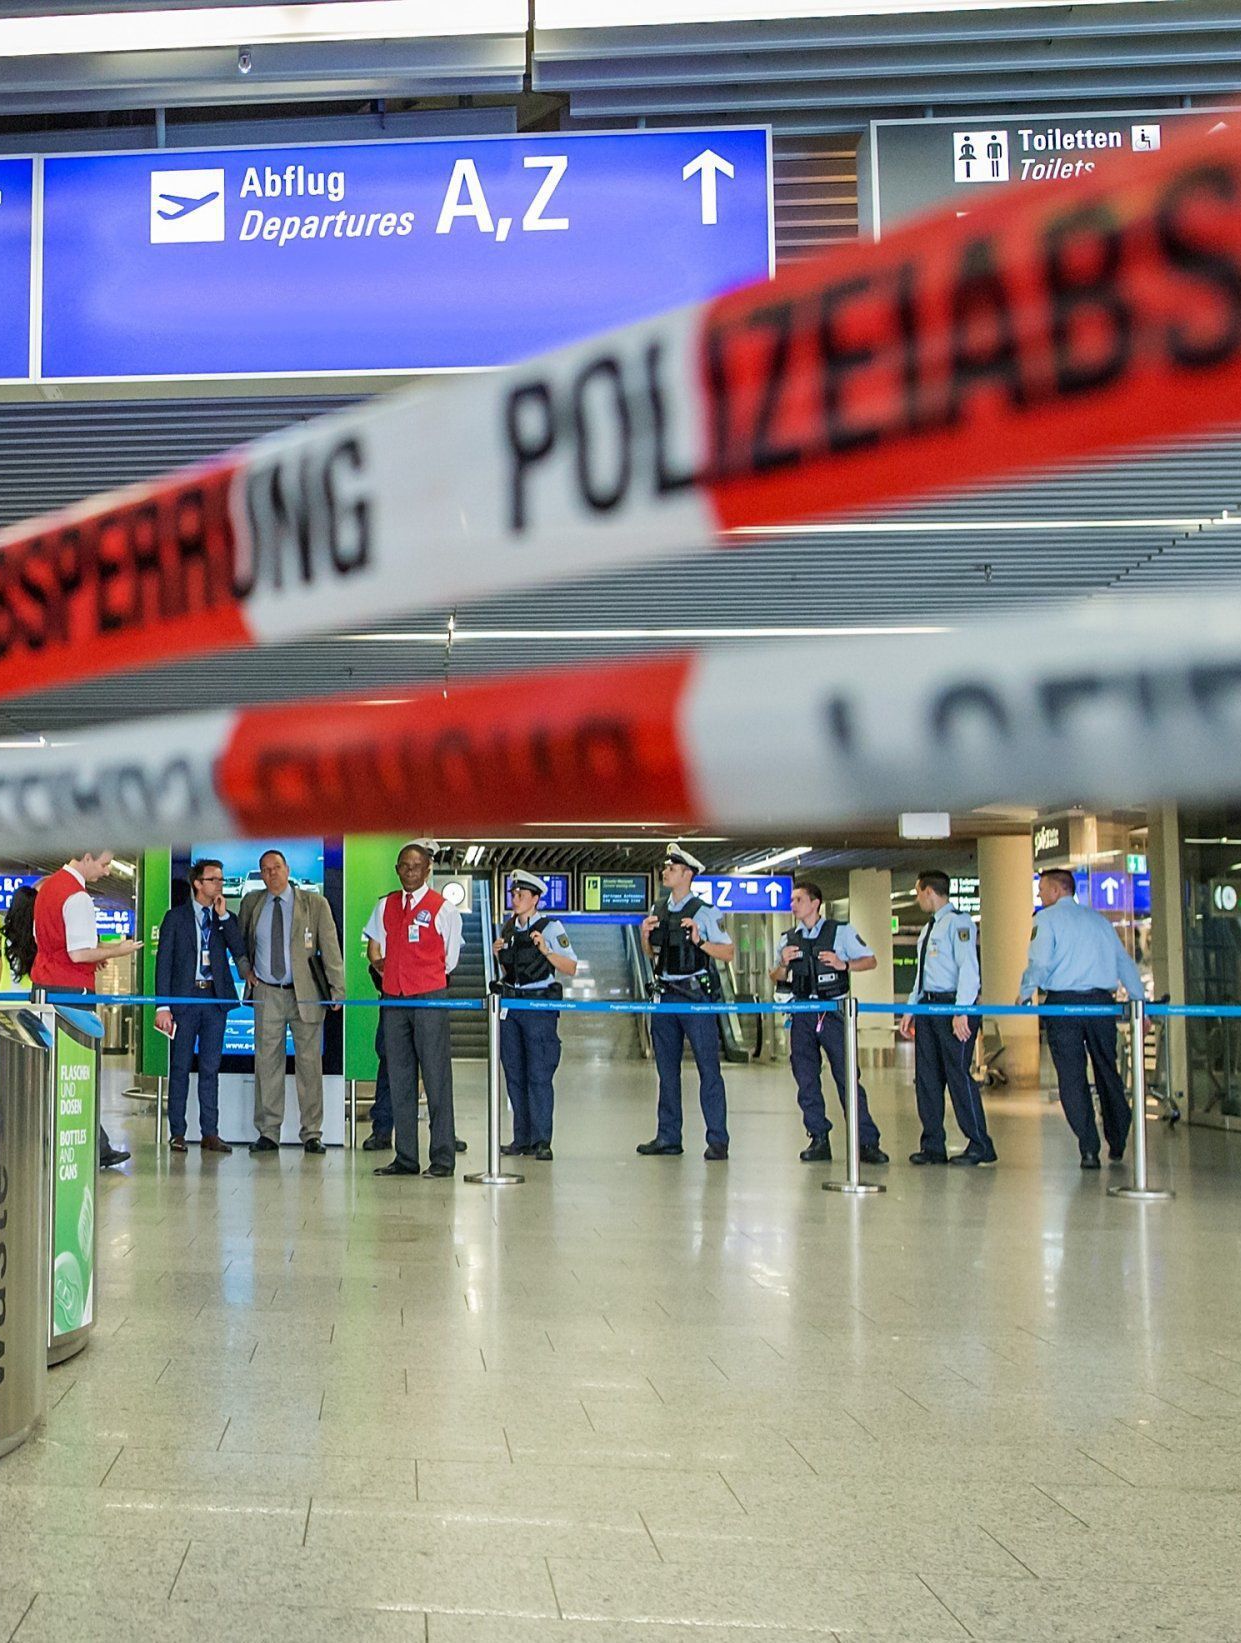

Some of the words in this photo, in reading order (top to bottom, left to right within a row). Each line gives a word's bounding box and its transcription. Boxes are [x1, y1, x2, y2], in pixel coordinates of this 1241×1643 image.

[1018, 128, 1122, 152] Toiletten
[239, 165, 345, 202] Abflug
[436, 155, 570, 243] A,Z
[239, 210, 415, 247] Departures
[717, 881, 733, 907] Z
[60, 1065, 91, 1081] FLASCHEN
[61, 1082, 76, 1097] UND
[60, 1099, 82, 1115] DOSEN
[60, 1129, 87, 1146] BOTTLES
[60, 1147, 75, 1163] AND
[60, 1163, 78, 1181] CANS
